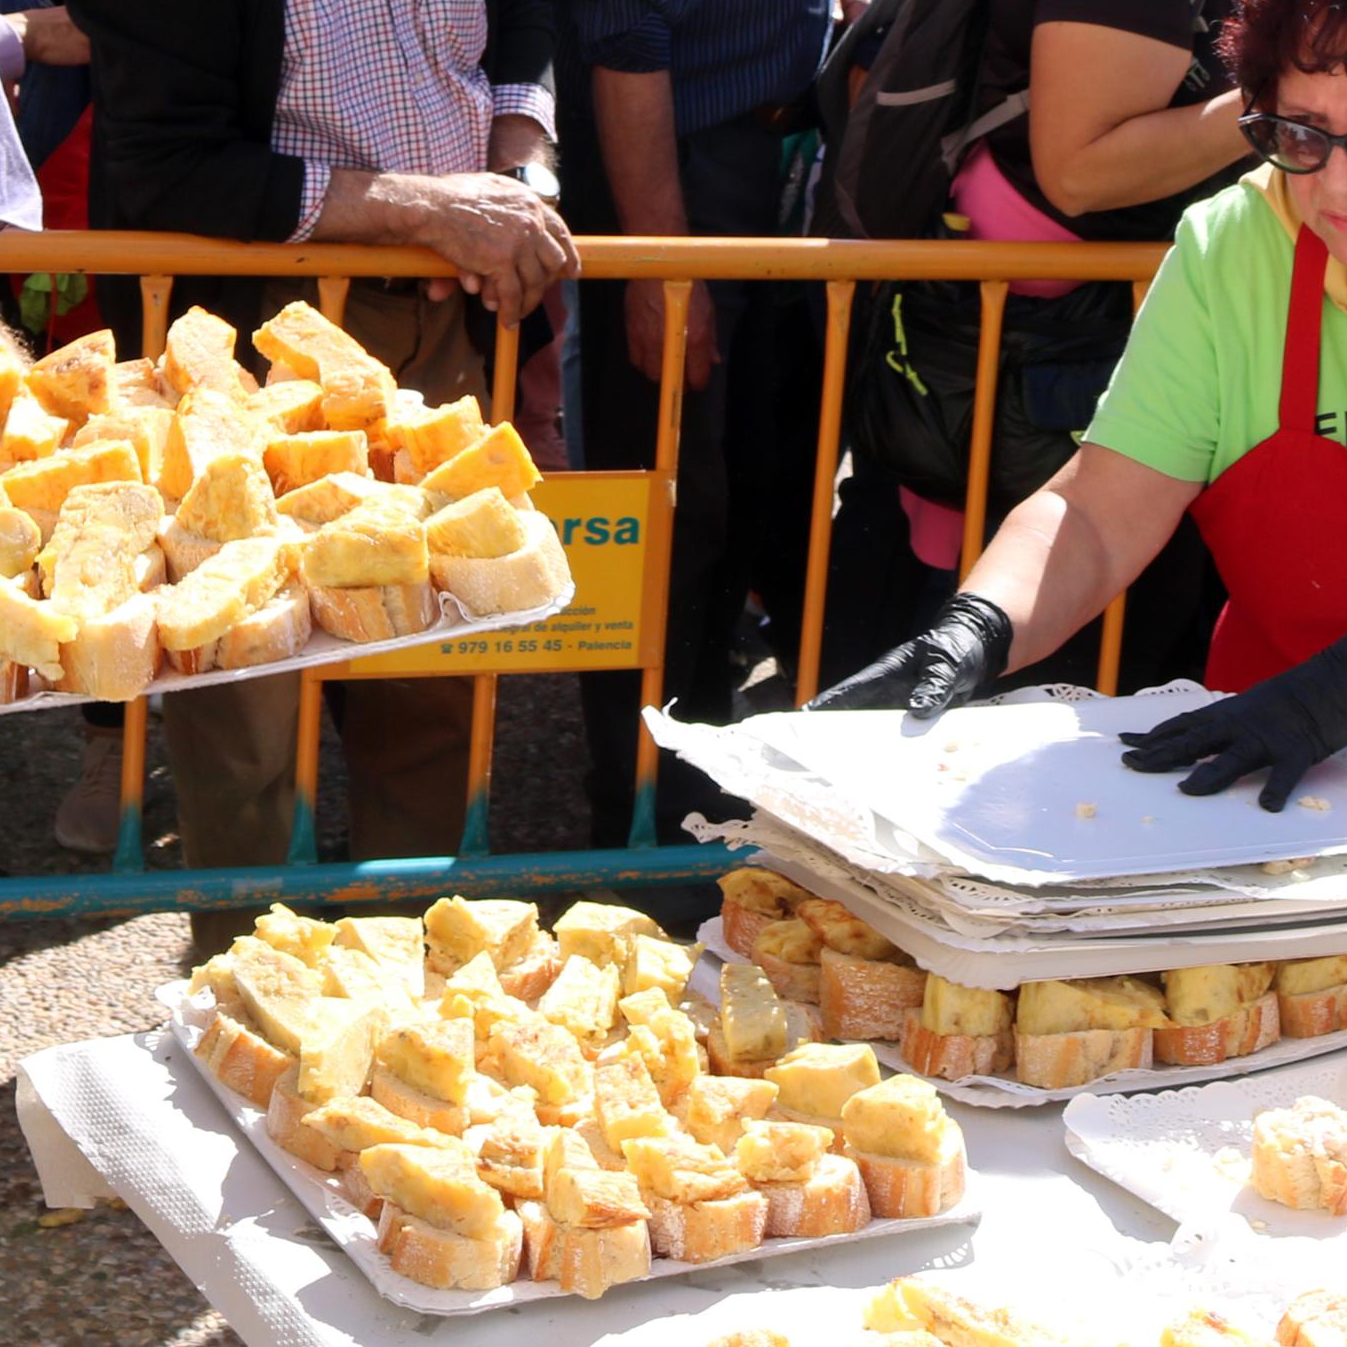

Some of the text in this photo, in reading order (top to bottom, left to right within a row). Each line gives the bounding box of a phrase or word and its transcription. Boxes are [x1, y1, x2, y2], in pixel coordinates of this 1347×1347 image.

[550, 516, 640, 546] rsa
[458, 641, 488, 654] 979
[495, 640, 513, 653] 16
[518, 639, 538, 653] 55
[543, 639, 562, 652] 45
[578, 640, 632, 651] Palencia
